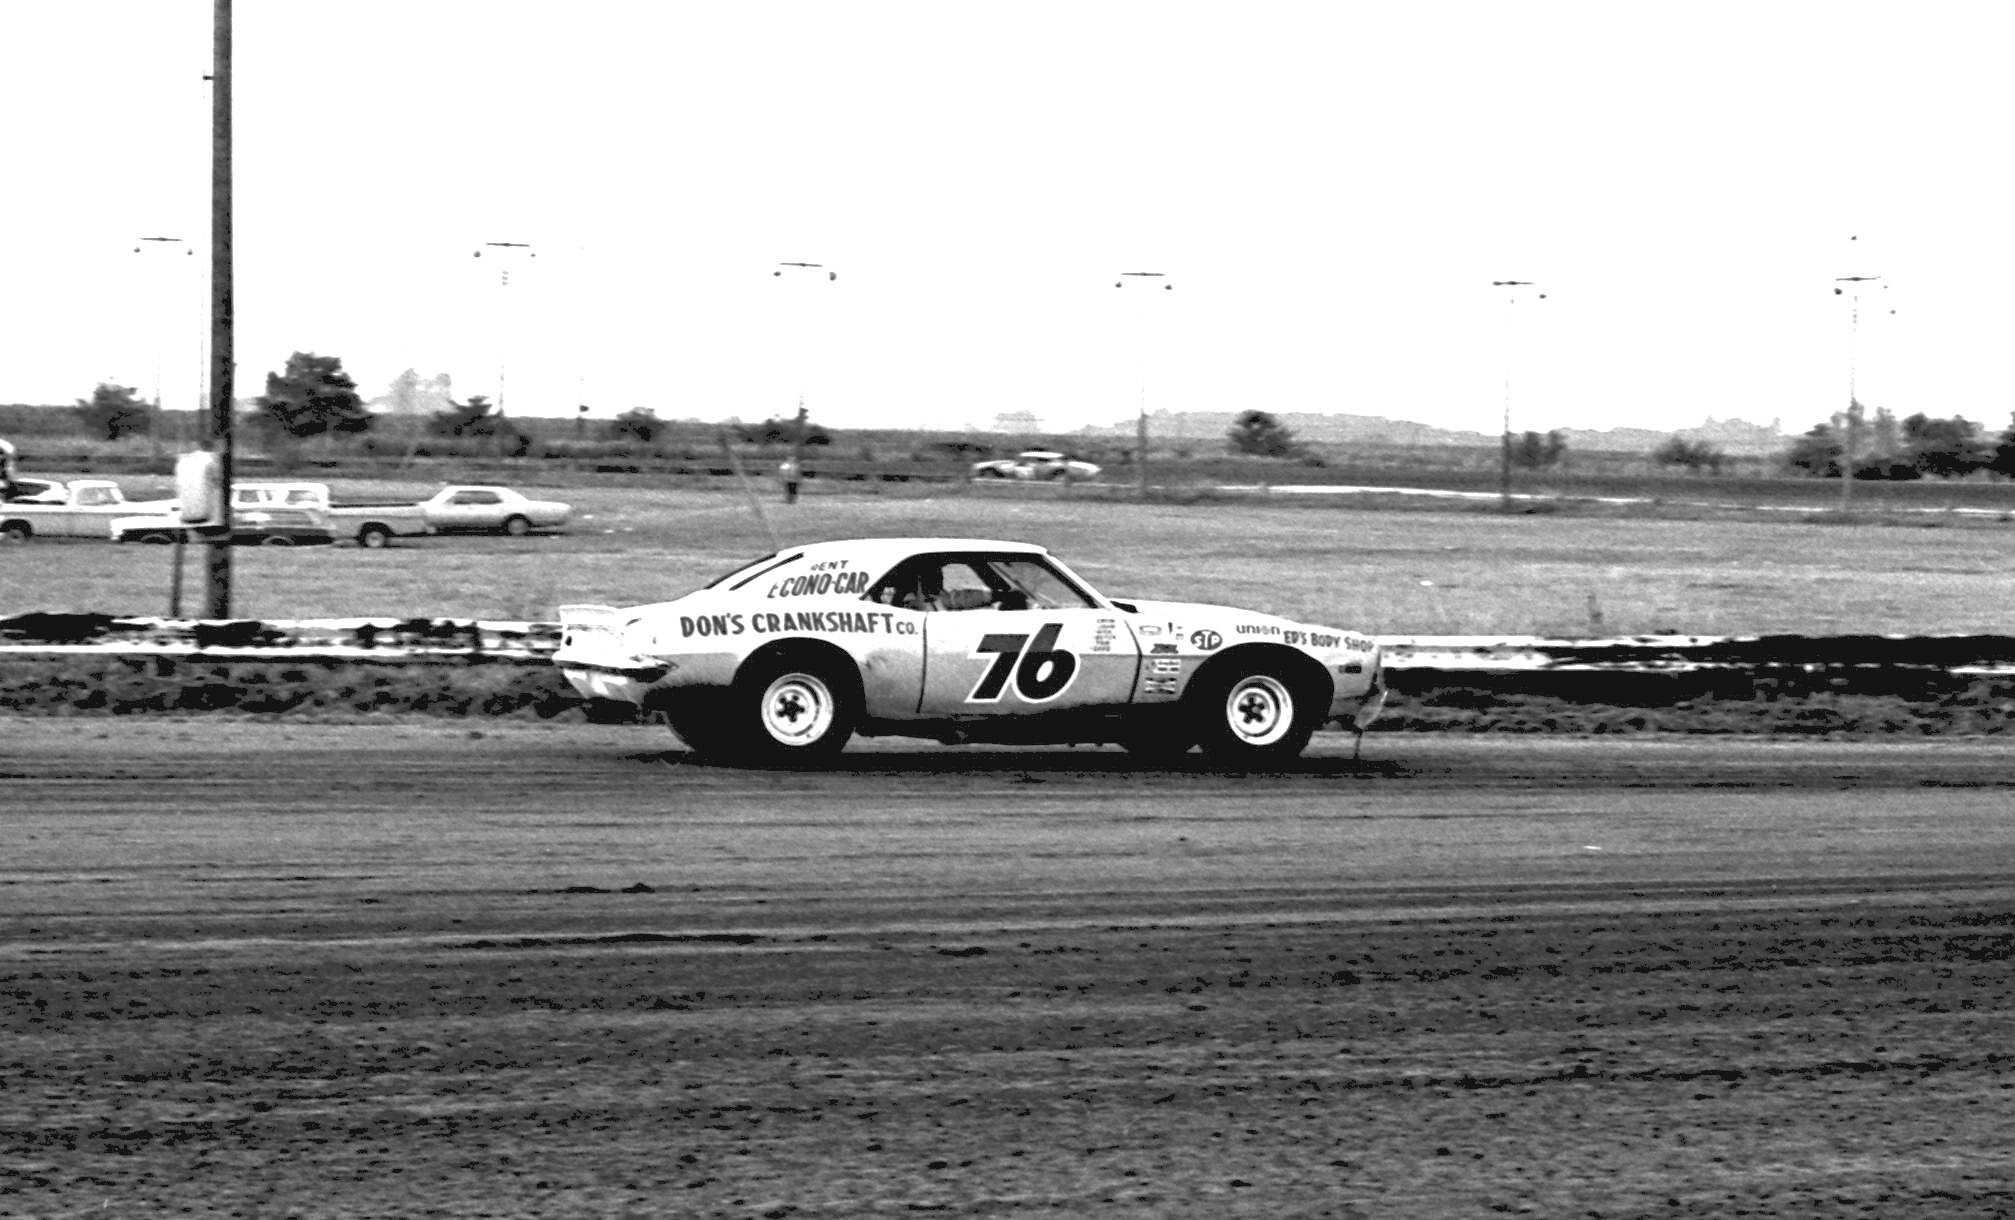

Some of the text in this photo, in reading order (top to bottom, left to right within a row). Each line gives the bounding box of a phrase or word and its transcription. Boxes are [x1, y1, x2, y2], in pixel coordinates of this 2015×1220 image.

[680, 612, 918, 637] DON'S CRANKSHAFT CO.
[1192, 630, 1221, 649] STP
[1283, 630, 1374, 652] ED'S BODY SHOP
[968, 623, 1077, 701] 76
